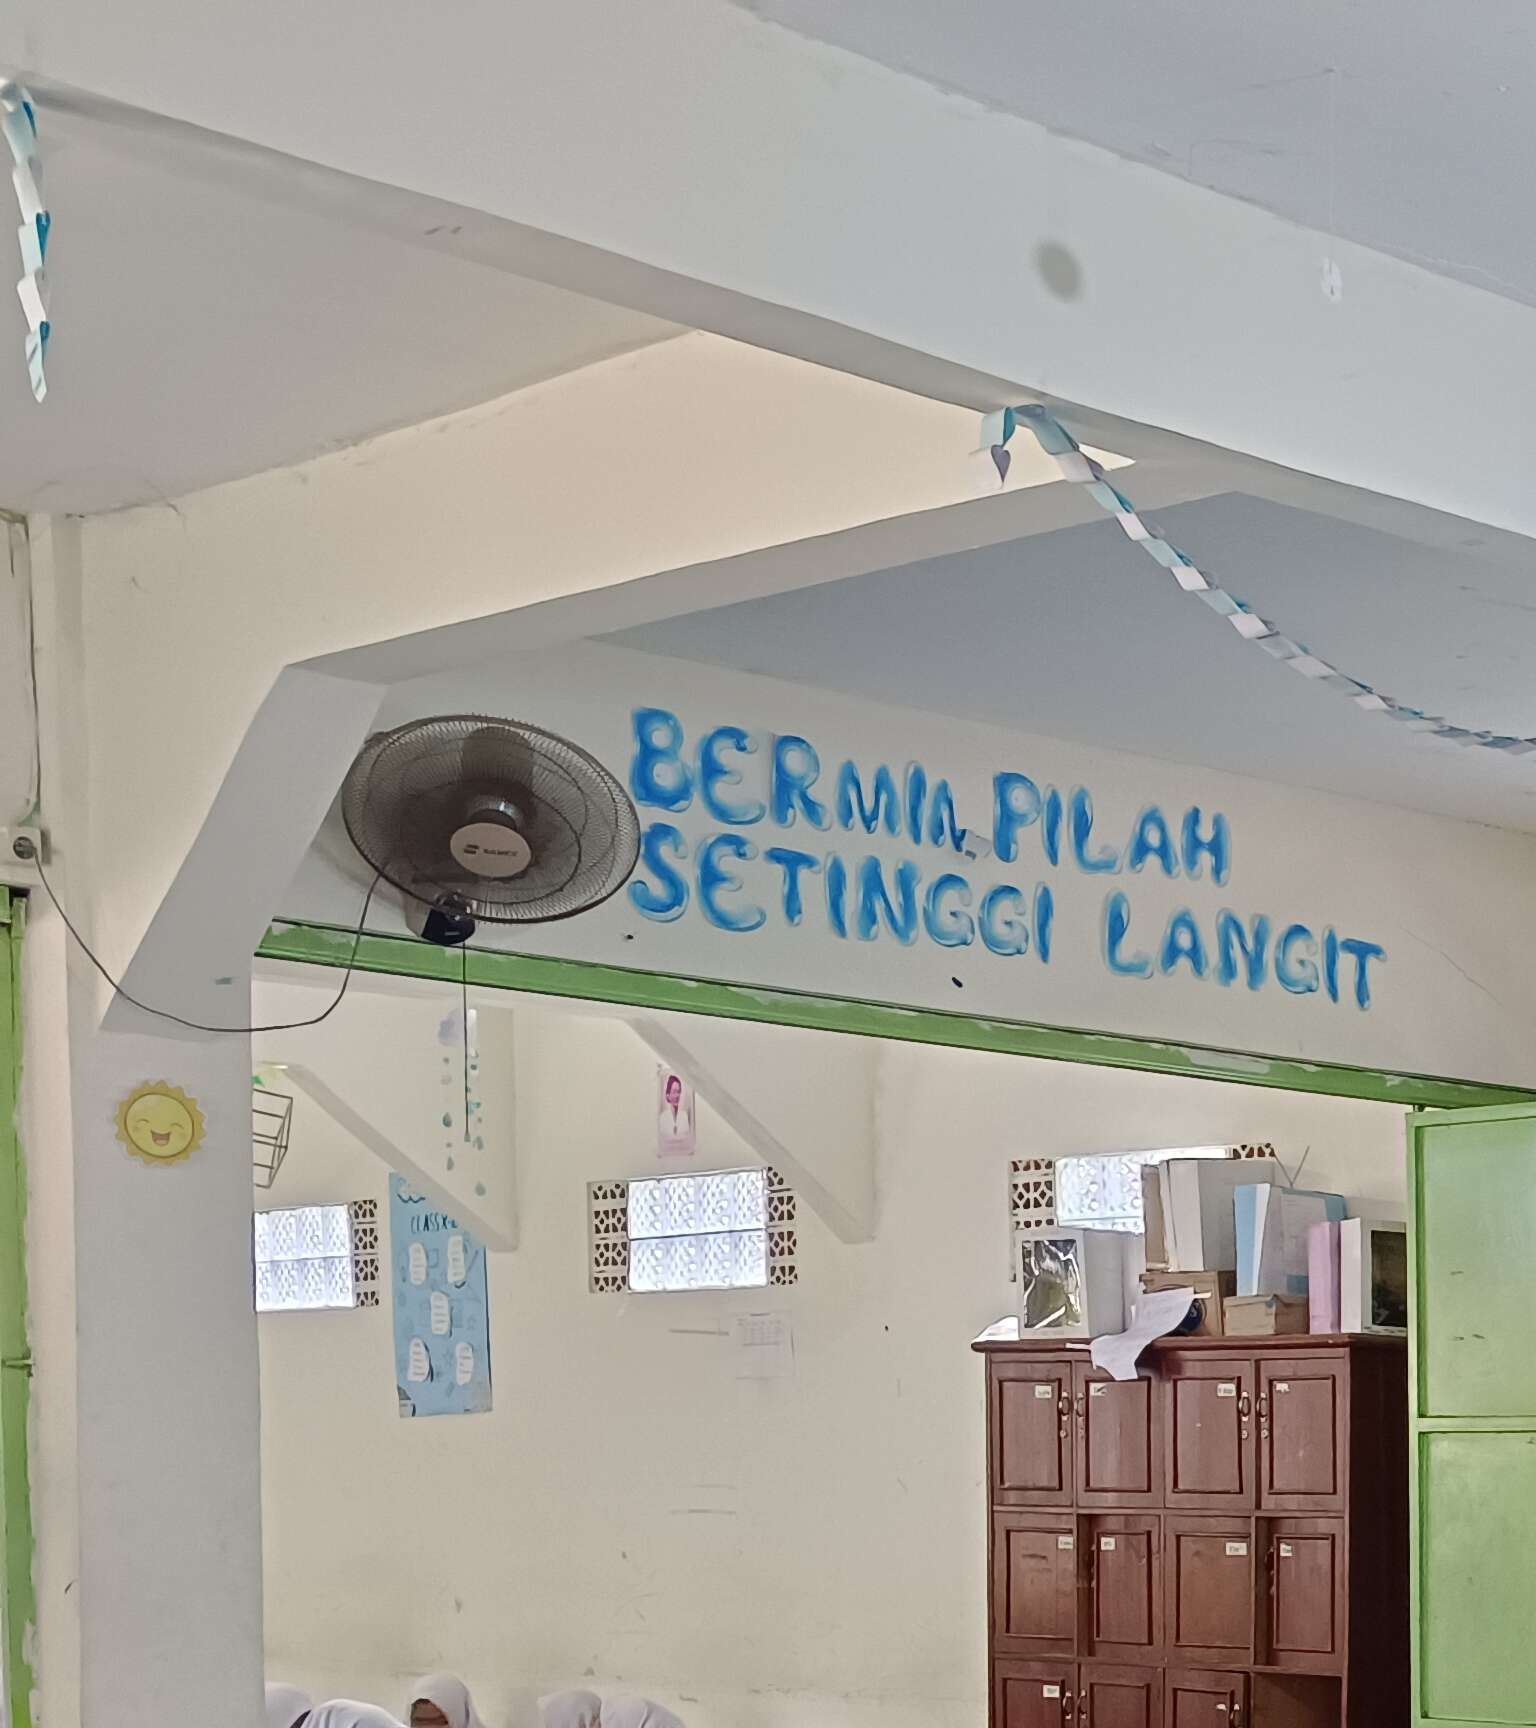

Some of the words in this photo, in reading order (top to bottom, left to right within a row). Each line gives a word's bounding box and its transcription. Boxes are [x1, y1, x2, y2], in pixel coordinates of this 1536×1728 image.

[628, 821, 1054, 963] SETINGGI
[1102, 890, 1387, 1010] LANGIT
[410, 1212, 440, 1233] CLASS
